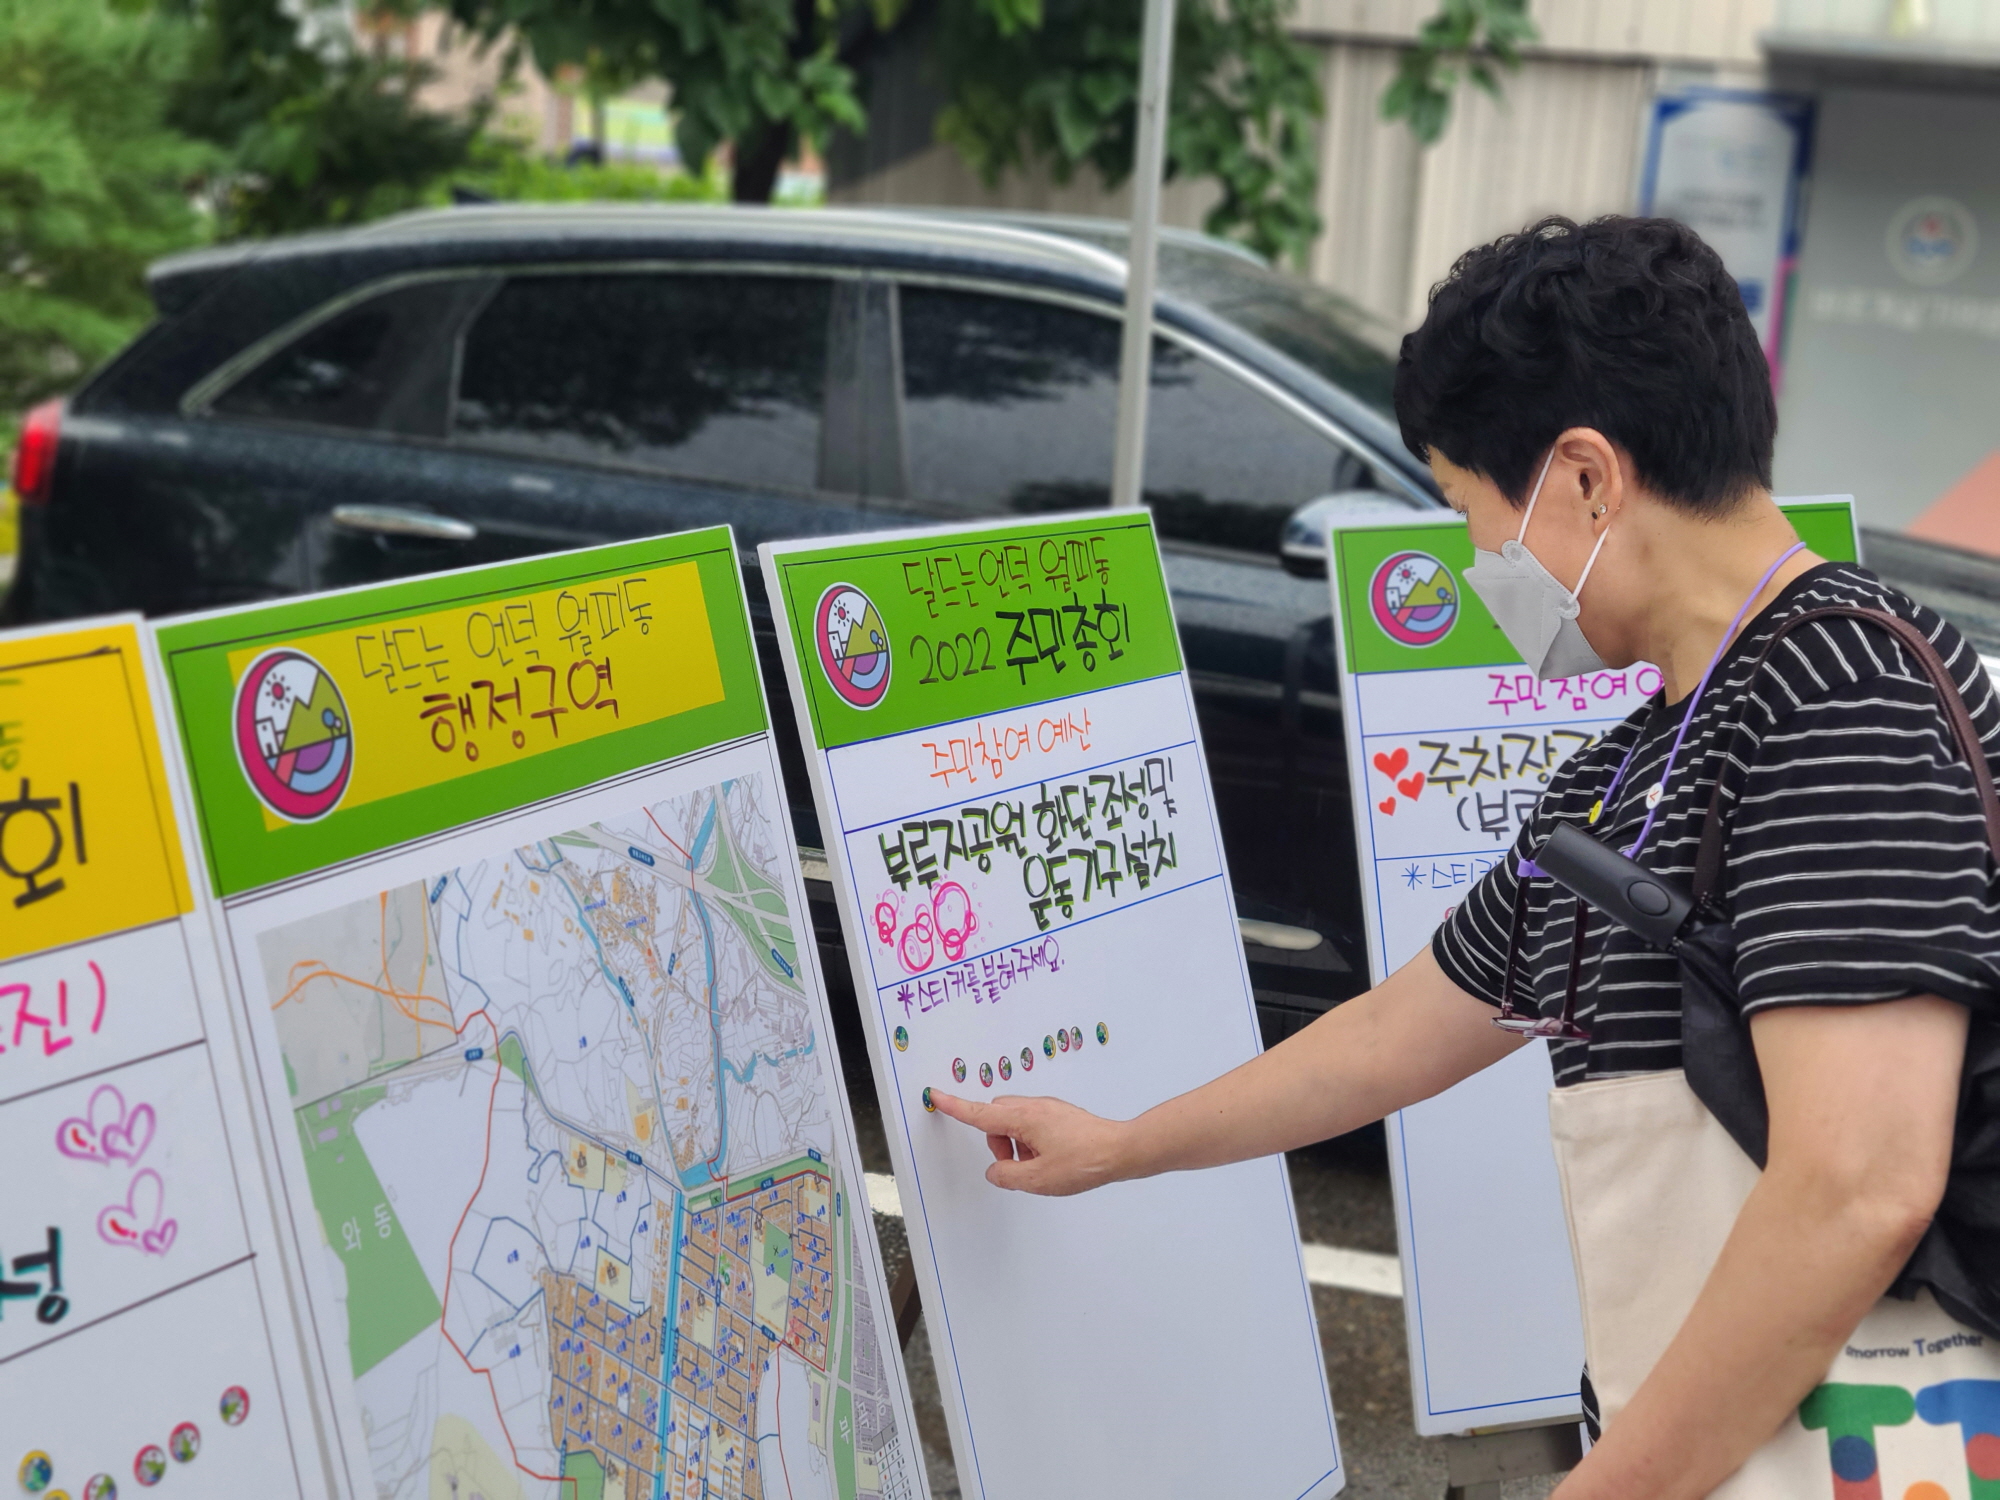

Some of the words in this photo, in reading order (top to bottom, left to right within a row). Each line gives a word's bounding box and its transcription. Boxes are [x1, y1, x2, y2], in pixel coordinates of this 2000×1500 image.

[978, 545, 1032, 598] 언덕
[1038, 537, 1110, 593] 월피동
[466, 600, 540, 666] 언덕
[556, 578, 652, 656] 월피동
[909, 626, 997, 685] 2022
[995, 588, 1130, 686] 주민총회
[419, 656, 619, 761] 행정구역
[921, 722, 1032, 788] 주민참여
[1037, 707, 1092, 752] 예산
[1845, 1345, 1910, 1359] omorrow
[1913, 1332, 1983, 1356] Together
